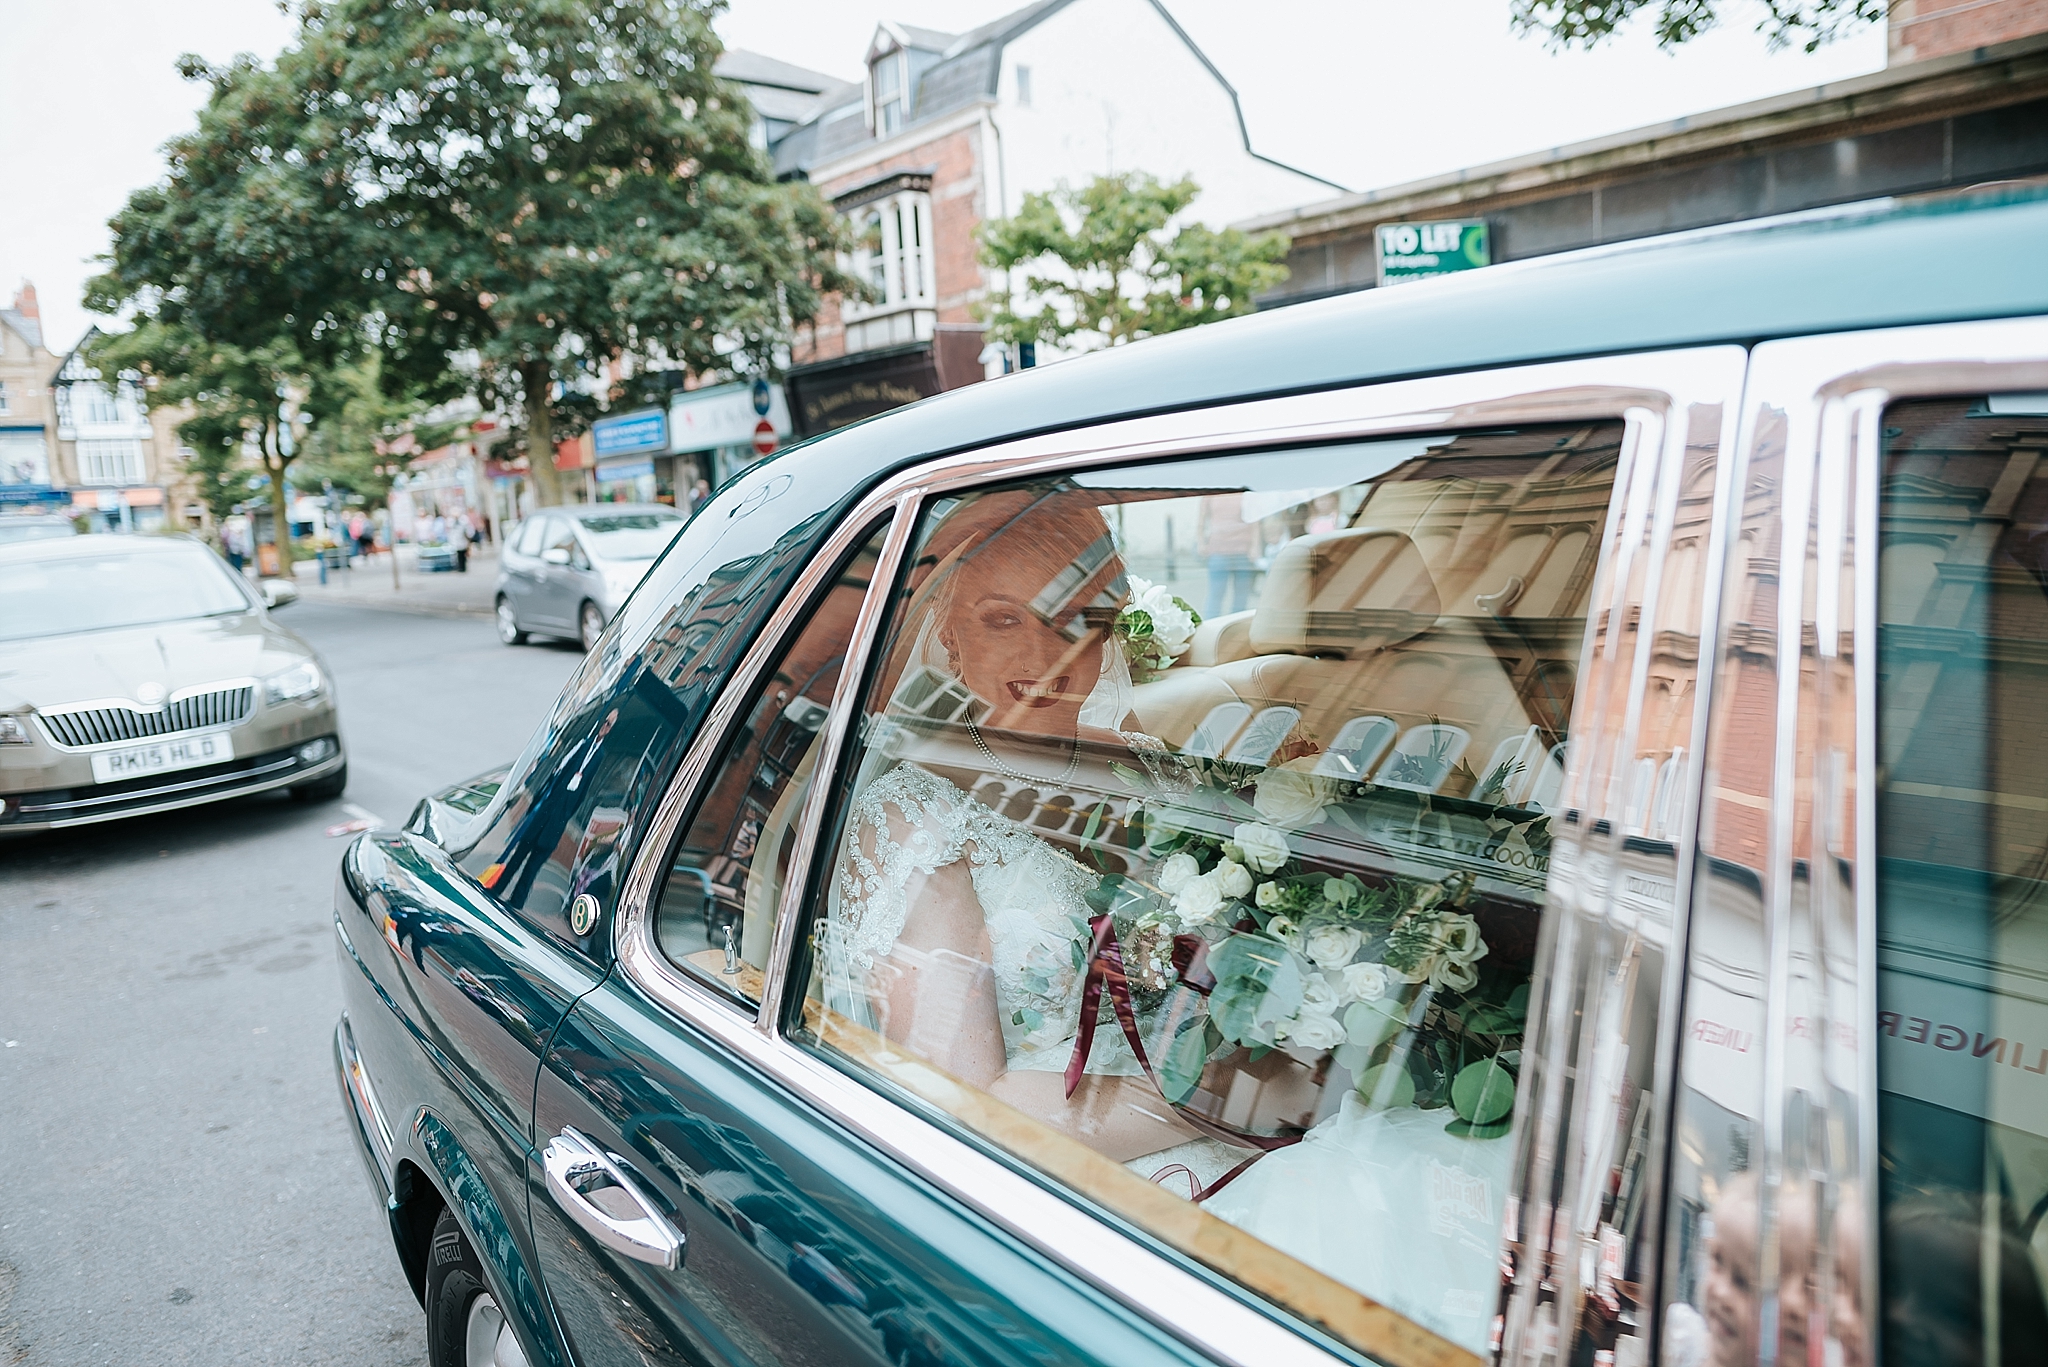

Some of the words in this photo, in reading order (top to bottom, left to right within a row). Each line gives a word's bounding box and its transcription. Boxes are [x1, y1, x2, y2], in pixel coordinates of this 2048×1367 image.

[1380, 224, 1418, 254] TO
[1420, 222, 1463, 253] LET
[108, 749, 164, 774] RK15
[575, 902, 586, 927] 8
[434, 1231, 463, 1266] PIRELLI
